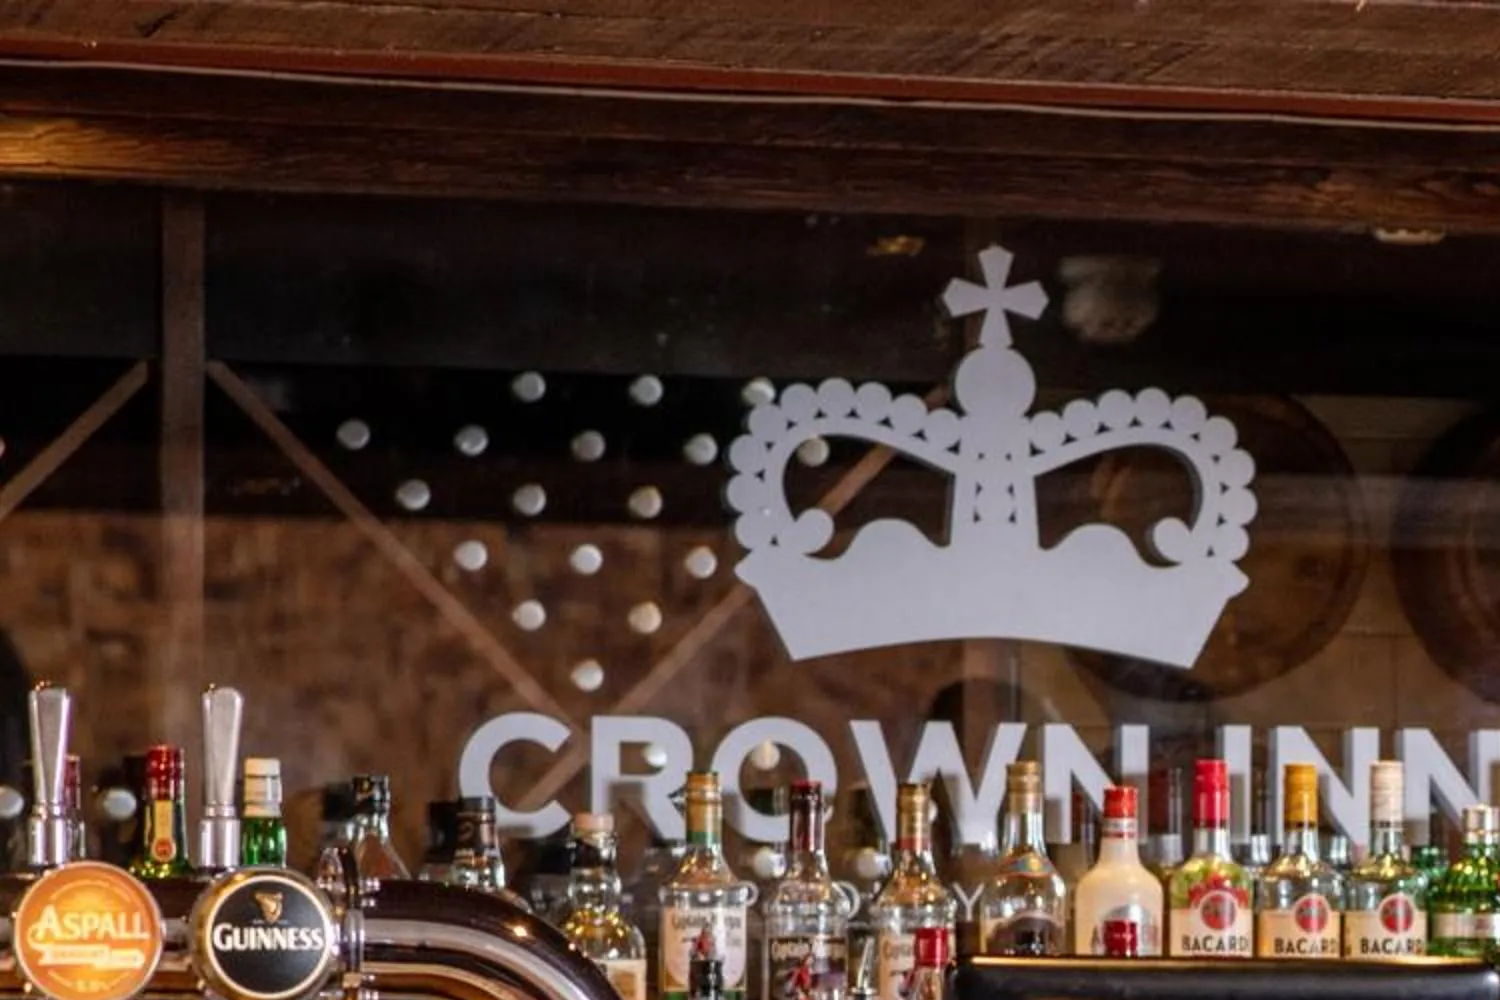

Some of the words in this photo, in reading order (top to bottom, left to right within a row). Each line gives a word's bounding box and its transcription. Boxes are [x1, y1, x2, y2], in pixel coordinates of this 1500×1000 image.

[458, 711, 1150, 843] CROWN
[27, 904, 150, 942] ASPALL
[213, 922, 324, 951] GUINNESS
